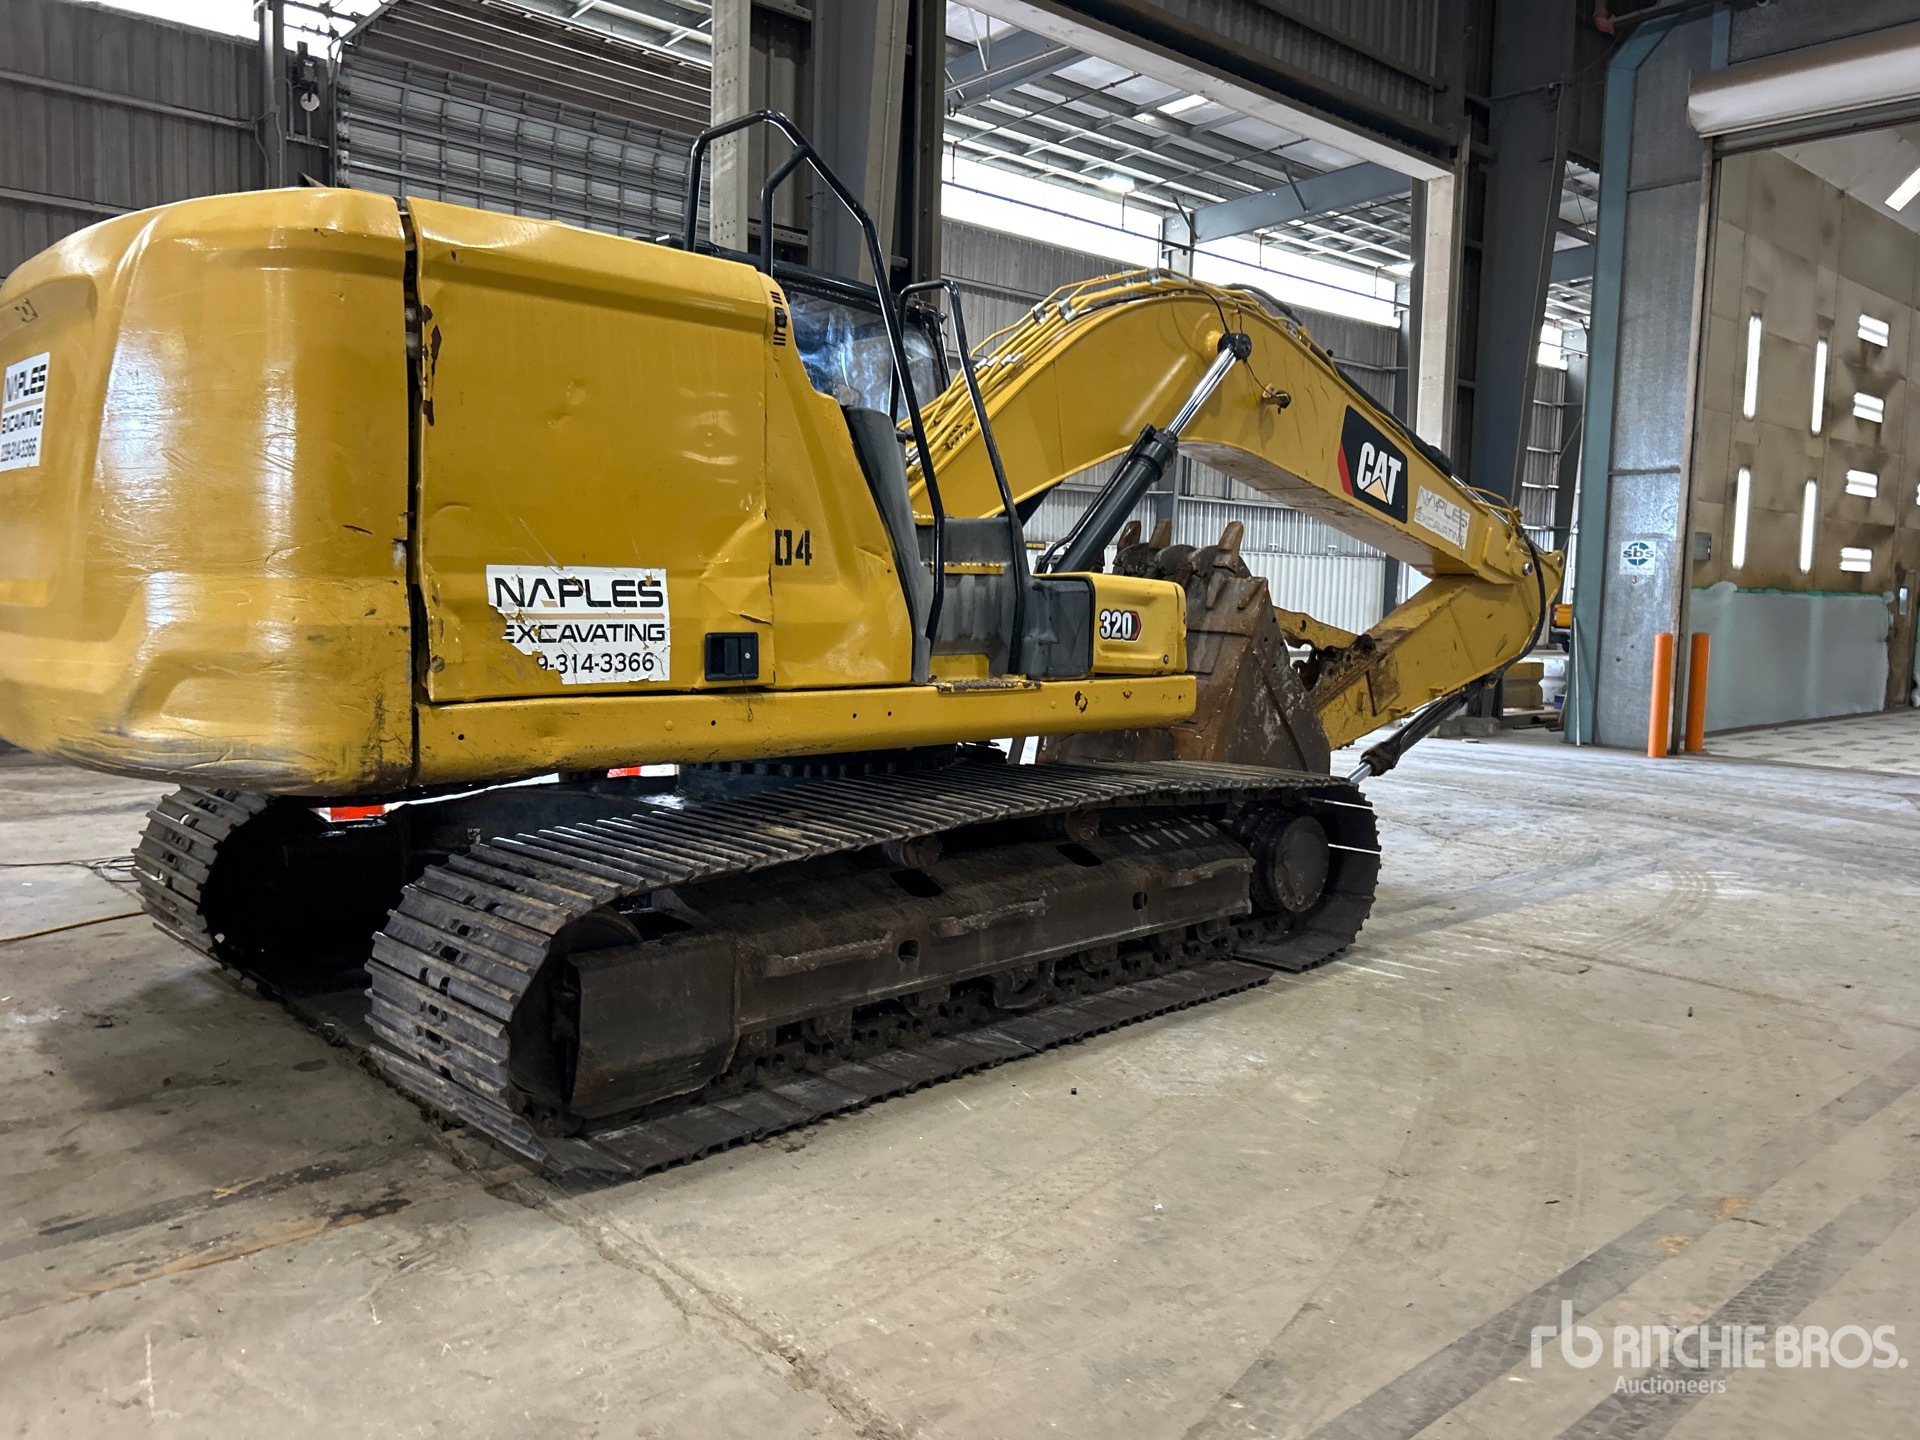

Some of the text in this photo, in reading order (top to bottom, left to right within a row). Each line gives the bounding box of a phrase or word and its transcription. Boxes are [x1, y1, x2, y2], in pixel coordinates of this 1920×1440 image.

[4, 364, 47, 402] NAPLES
[1356, 442, 1402, 505] CAT
[1622, 547, 1655, 558] sbs
[494, 577, 664, 608] NAPLES
[1099, 609, 1133, 640] 320
